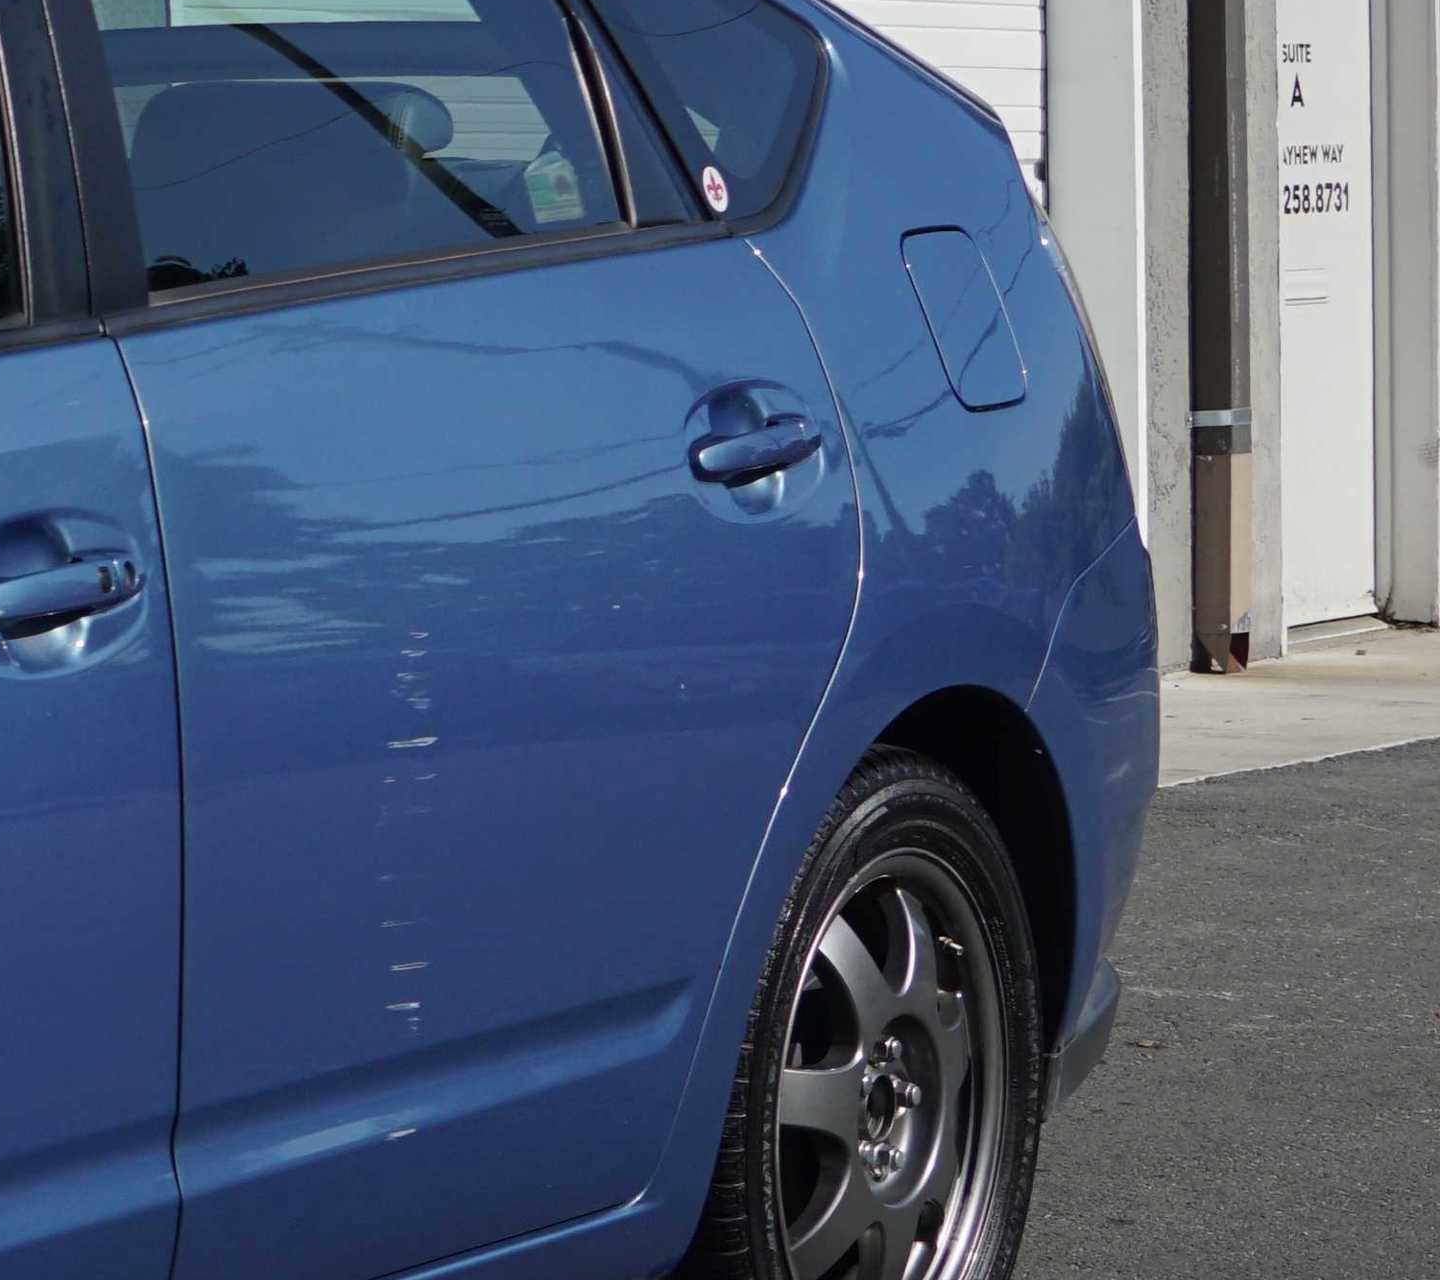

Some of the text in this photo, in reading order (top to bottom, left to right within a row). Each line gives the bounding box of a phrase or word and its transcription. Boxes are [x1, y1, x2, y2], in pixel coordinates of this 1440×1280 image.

[1282, 44, 1312, 63] SUITE
[1290, 72, 1305, 108] A
[1283, 144, 1344, 166] YHEW WAY
[1283, 182, 1350, 215] 258.8731
